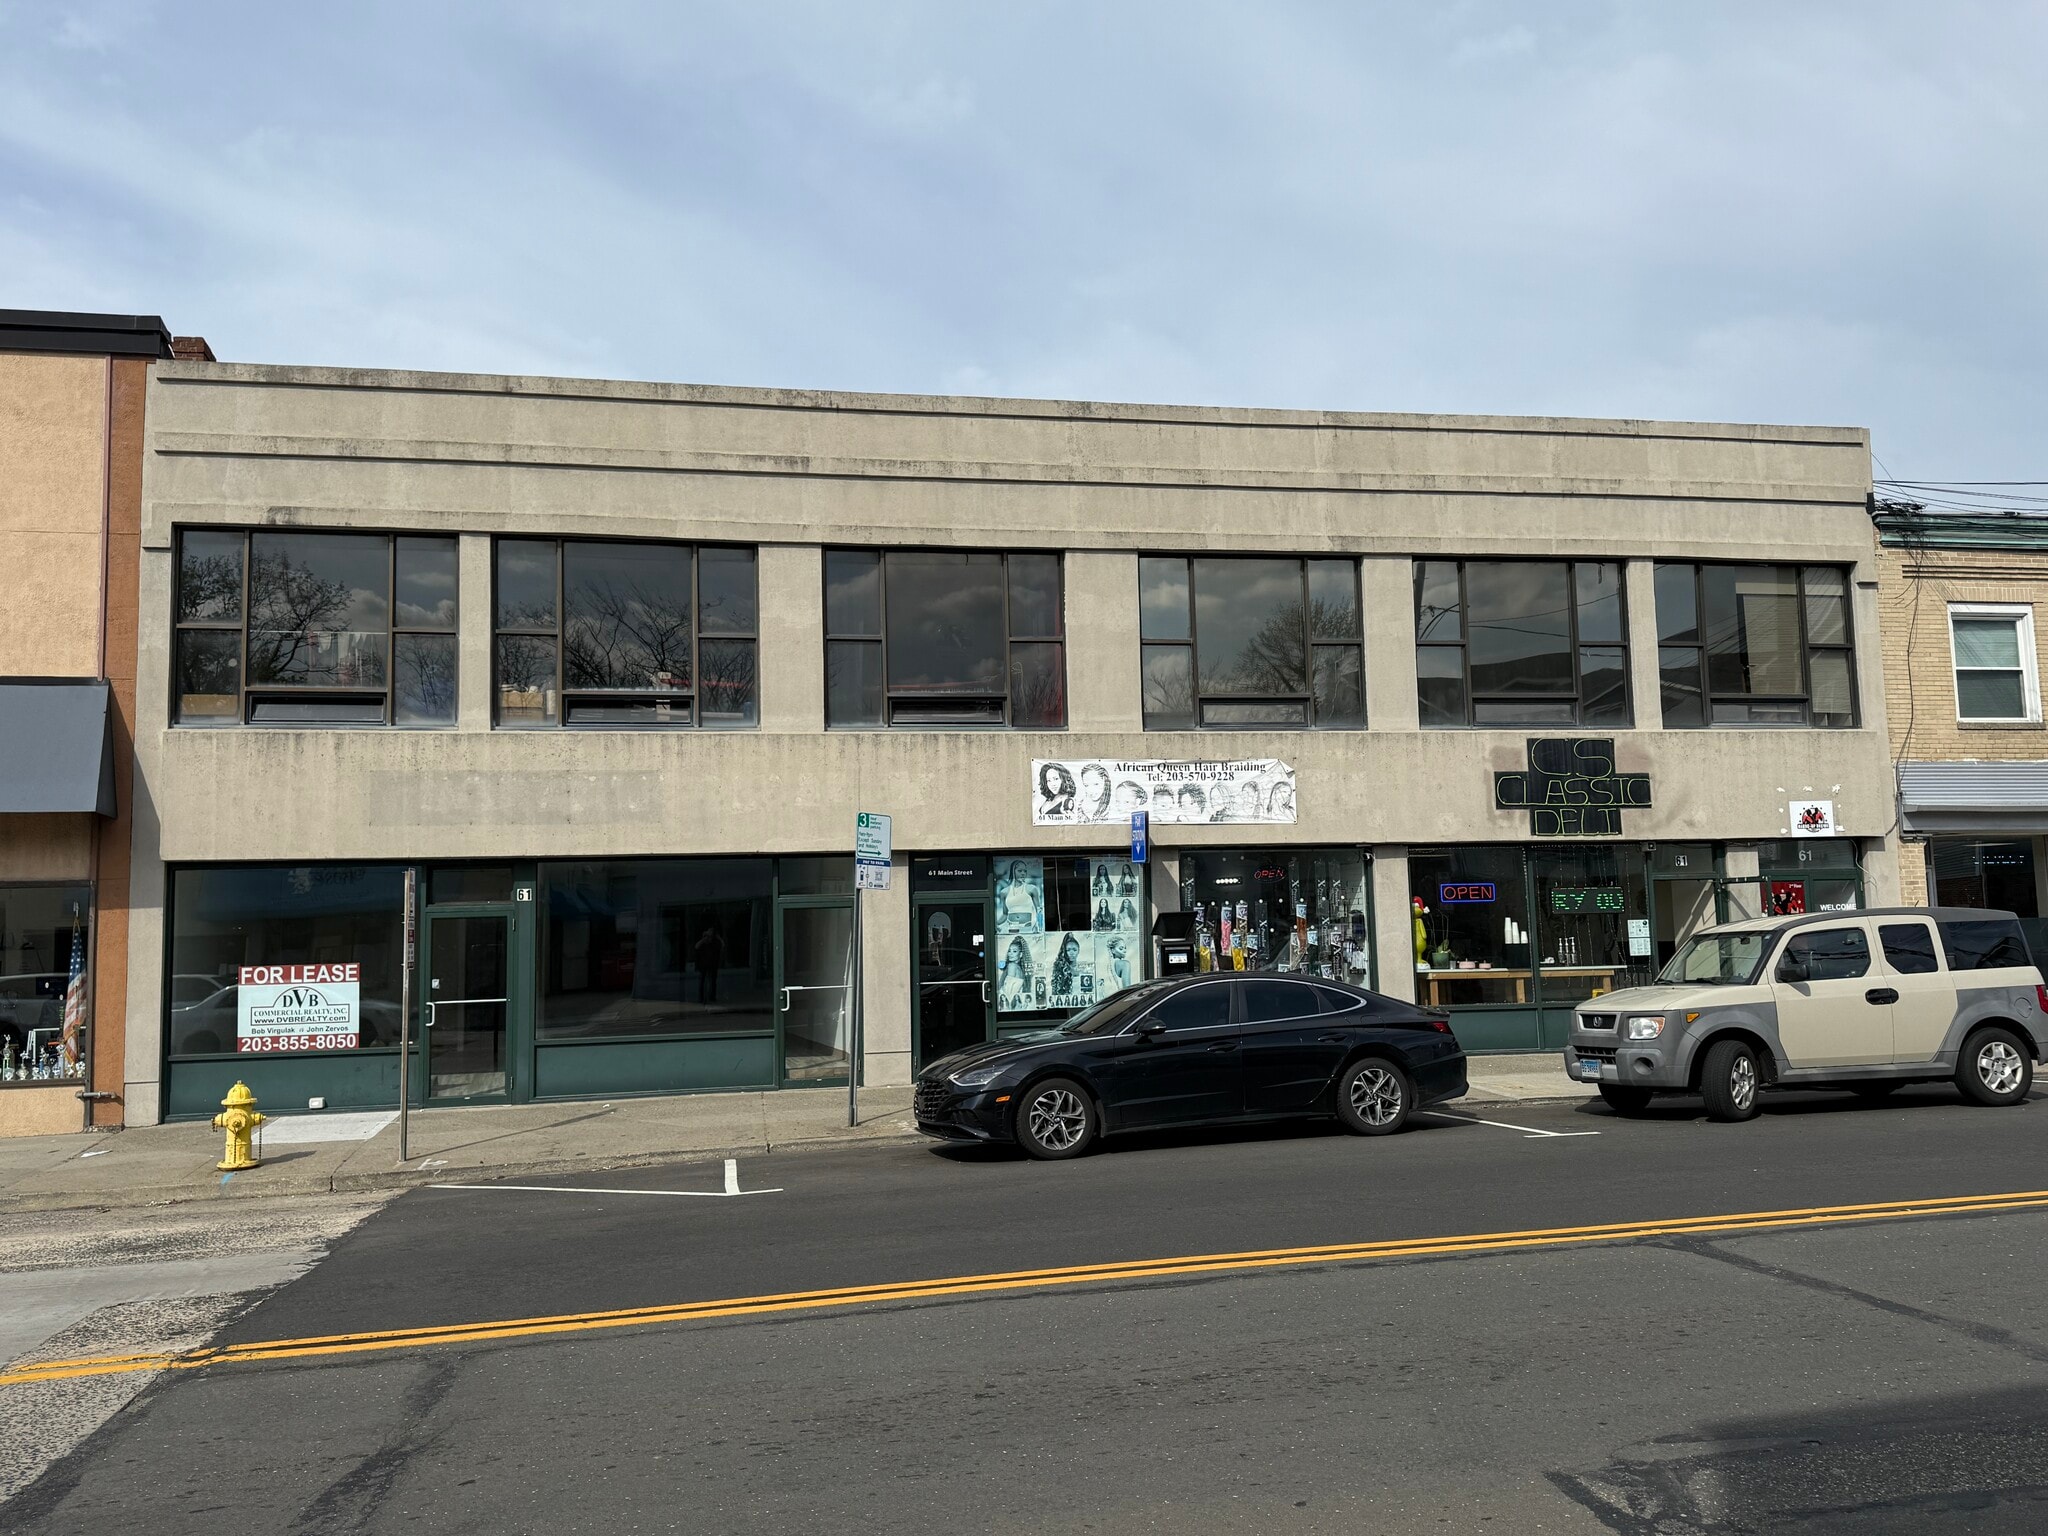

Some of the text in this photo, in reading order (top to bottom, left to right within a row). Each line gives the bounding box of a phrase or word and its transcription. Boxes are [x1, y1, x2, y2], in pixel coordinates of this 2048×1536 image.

[1532, 738, 1612, 779] CS
[1114, 762, 1267, 773] African Queen Hair Braiding
[1147, 772, 1235, 782] Tel: 203-570-9228
[1496, 775, 1652, 806] CLASSIC
[859, 813, 867, 827] 3
[1534, 808, 1619, 836] DELI
[1676, 856, 1686, 866] 61
[1799, 850, 1812, 861] 61
[1253, 867, 1284, 880] OPEN
[518, 889, 531, 901] 61
[1443, 886, 1492, 900] OPEN
[1820, 903, 1857, 911] WELCOME
[241, 964, 358, 985] FOR LEASE
[283, 989, 319, 1008] DVB
[253, 1009, 302, 1017] COMMERCIAL
[333, 1007, 348, 1015] INC.
[254, 1015, 347, 1024] www.DVBREALTY.com
[267, 1027, 295, 1035] Virgulak
[325, 1025, 349, 1033] Zervos
[241, 1033, 357, 1052] 203-855-8050
